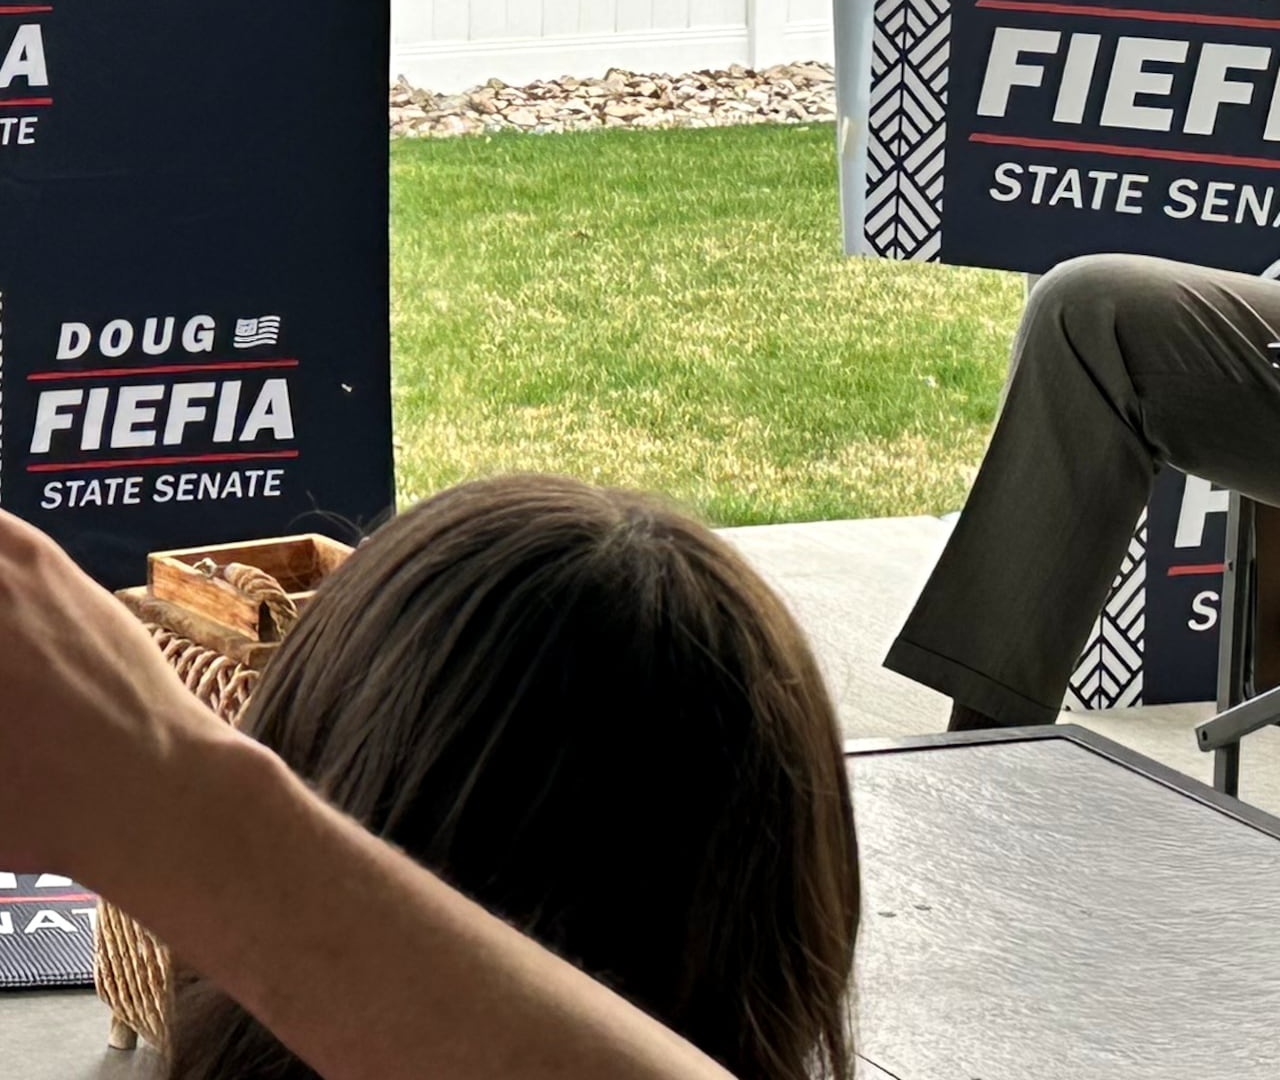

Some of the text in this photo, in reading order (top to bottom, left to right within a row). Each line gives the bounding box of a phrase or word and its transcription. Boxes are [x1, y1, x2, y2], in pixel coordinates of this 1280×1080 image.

[976, 26, 1280, 142] FIEF
[989, 162, 1280, 227] STATE SEN
[55, 314, 216, 360] DOUG
[29, 378, 295, 454] FIEFIA
[40, 469, 285, 510] STATE SENATE
